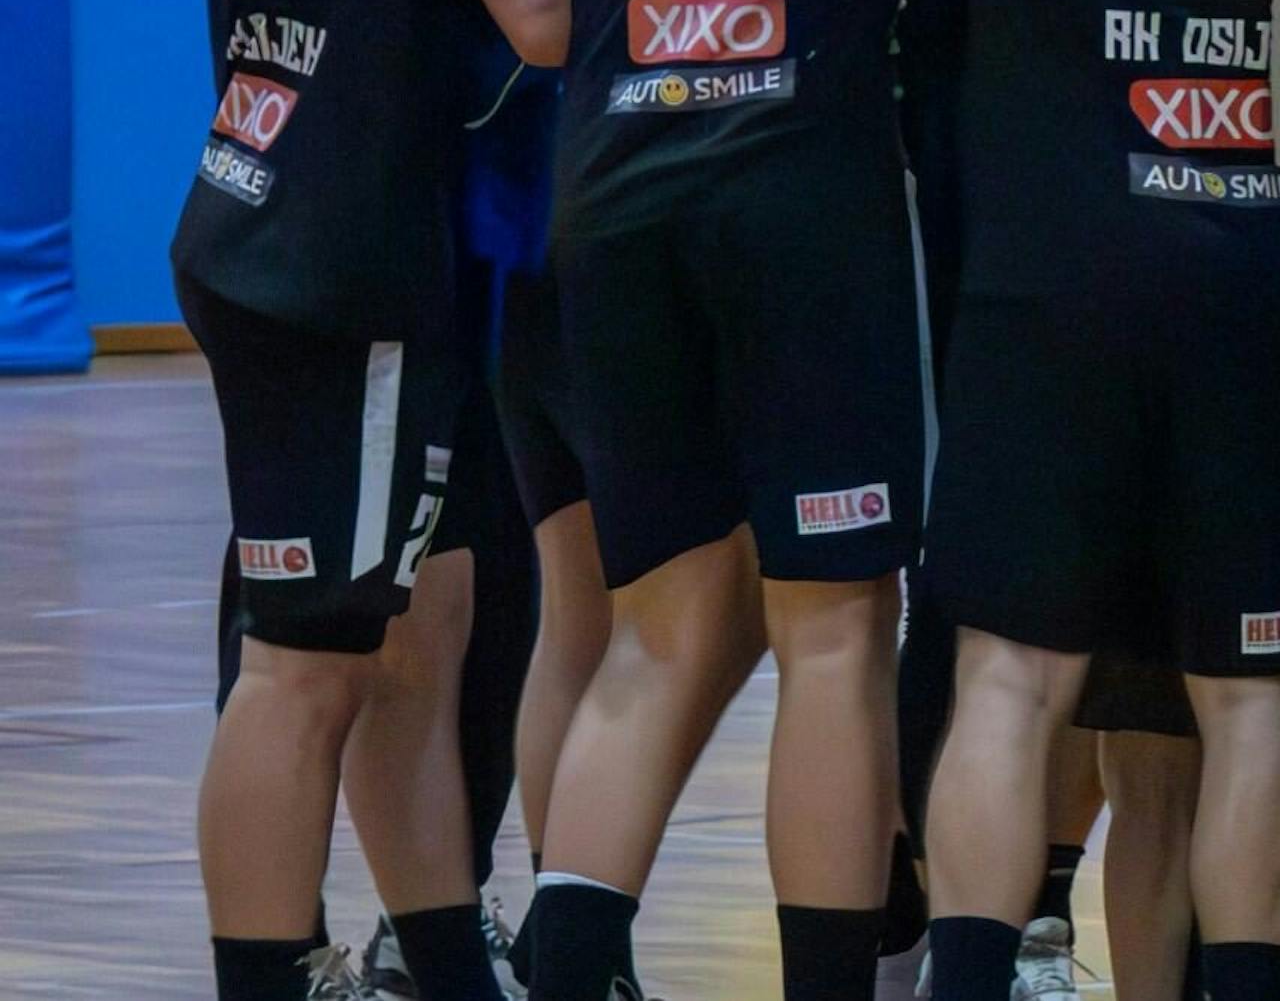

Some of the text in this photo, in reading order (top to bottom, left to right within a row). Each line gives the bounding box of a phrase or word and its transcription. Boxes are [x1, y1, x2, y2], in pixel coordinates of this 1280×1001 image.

[642, 4, 774, 56] XIXO
[1105, 10, 1271, 70] RK OSIJ
[694, 69, 781, 101] SMILE
